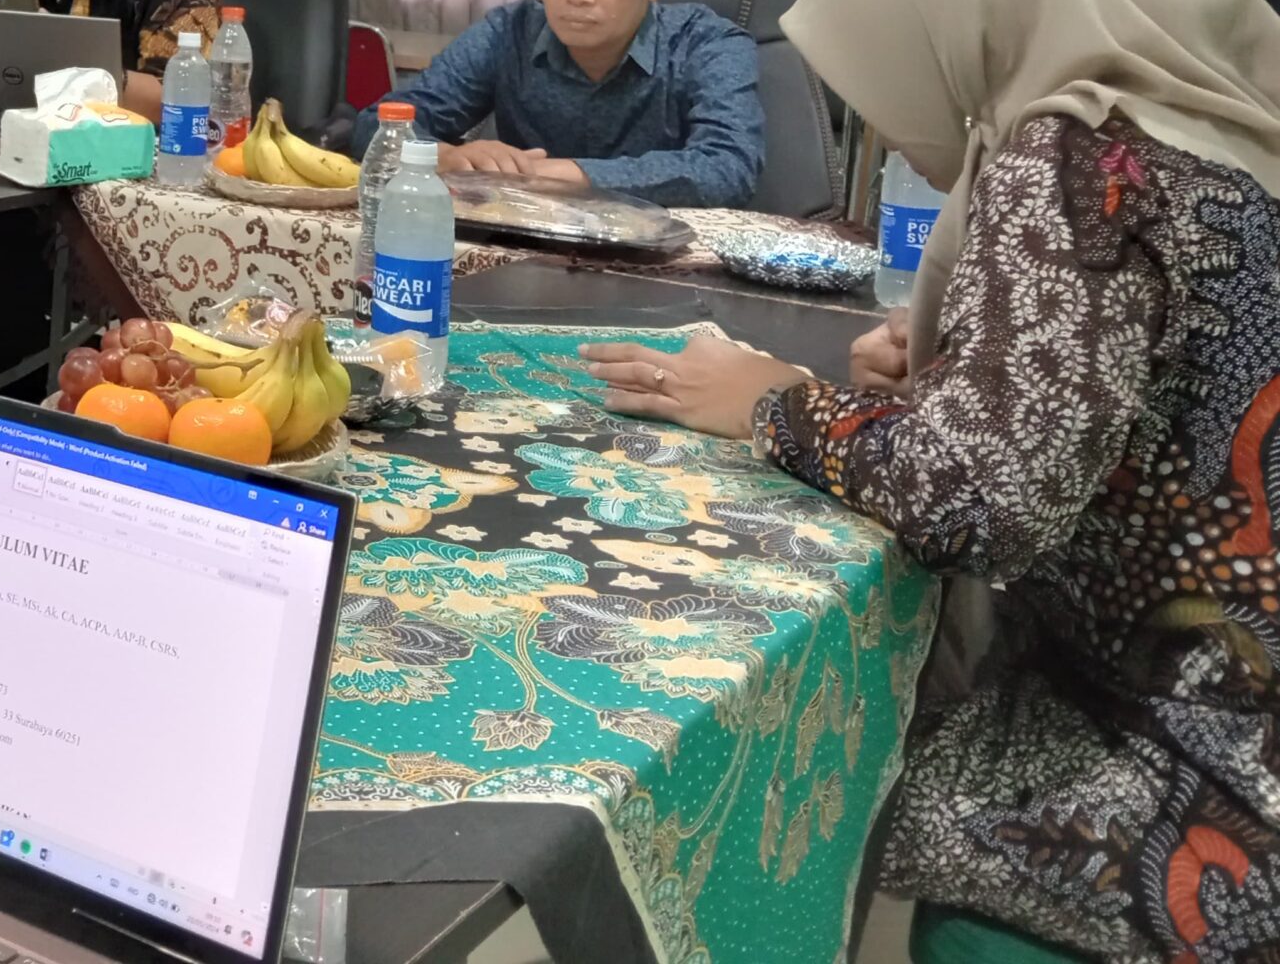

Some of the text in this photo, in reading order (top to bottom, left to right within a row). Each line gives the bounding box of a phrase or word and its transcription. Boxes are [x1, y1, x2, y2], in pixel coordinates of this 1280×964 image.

[192, 117, 207, 127] PO
[60, 161, 92, 177] Smart
[907, 222, 930, 234] PO
[42, 546, 90, 575] VITAE
